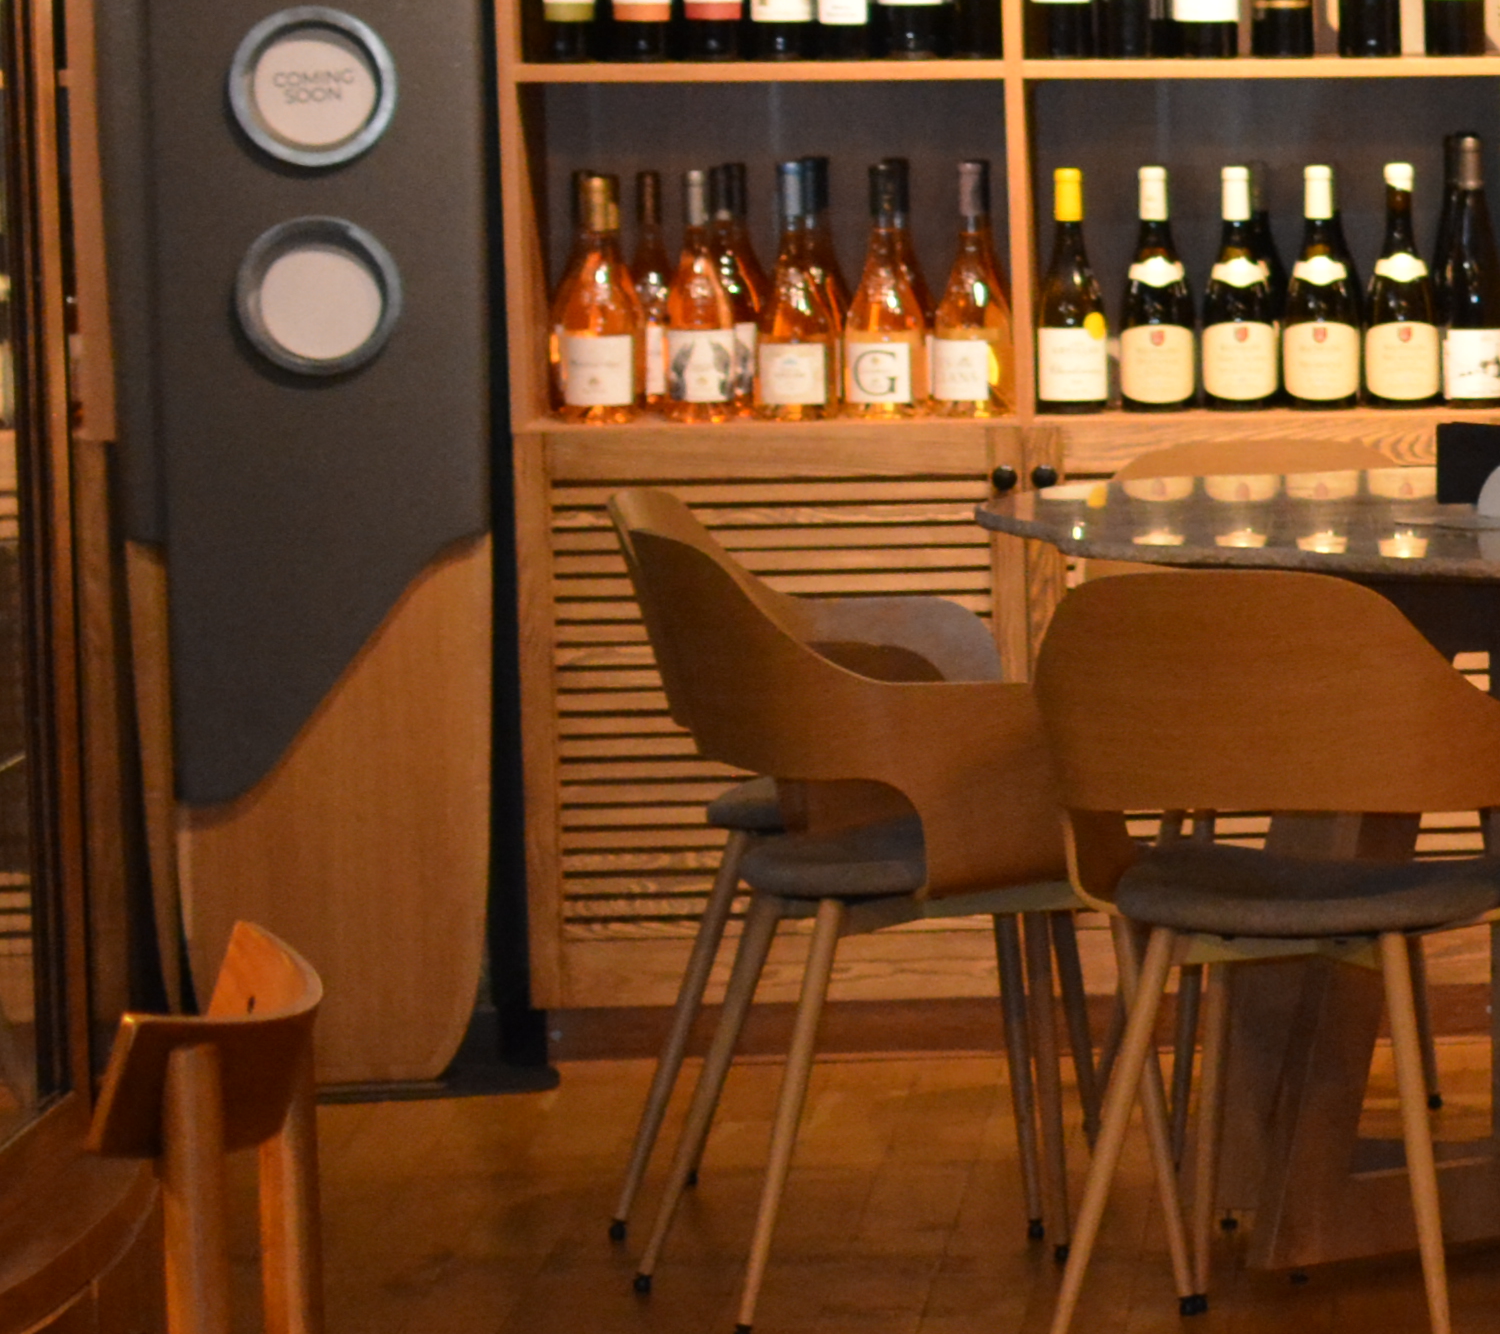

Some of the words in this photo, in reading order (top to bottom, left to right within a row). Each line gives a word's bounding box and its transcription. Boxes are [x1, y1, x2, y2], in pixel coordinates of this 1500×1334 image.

[273, 68, 354, 88] COMING
[285, 86, 343, 105] SOON
[853, 349, 897, 397] G
